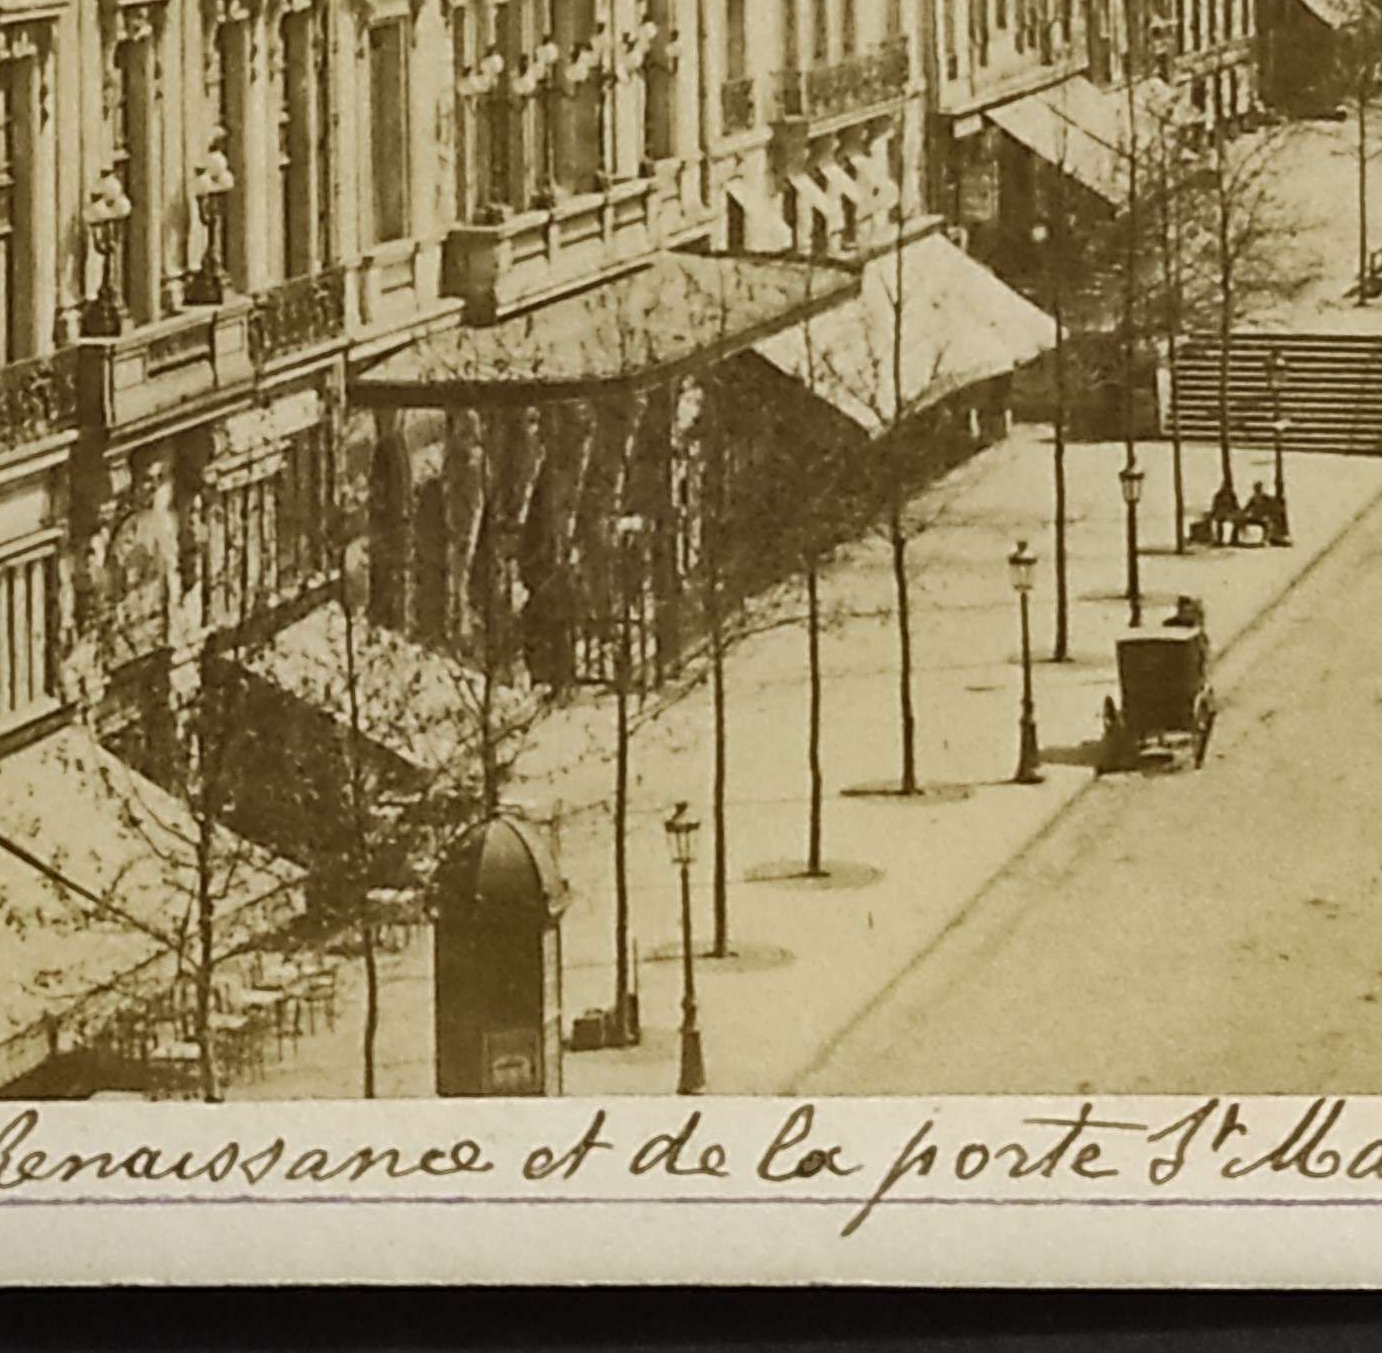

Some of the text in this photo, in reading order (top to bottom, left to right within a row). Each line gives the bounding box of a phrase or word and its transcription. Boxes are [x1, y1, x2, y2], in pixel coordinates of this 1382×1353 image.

[522, 1109, 613, 1181] et
[628, 1110, 730, 1178] de
[756, 1103, 862, 1183] la
[841, 1102, 1154, 1238] porte
[1147, 1097, 1247, 1185] St
